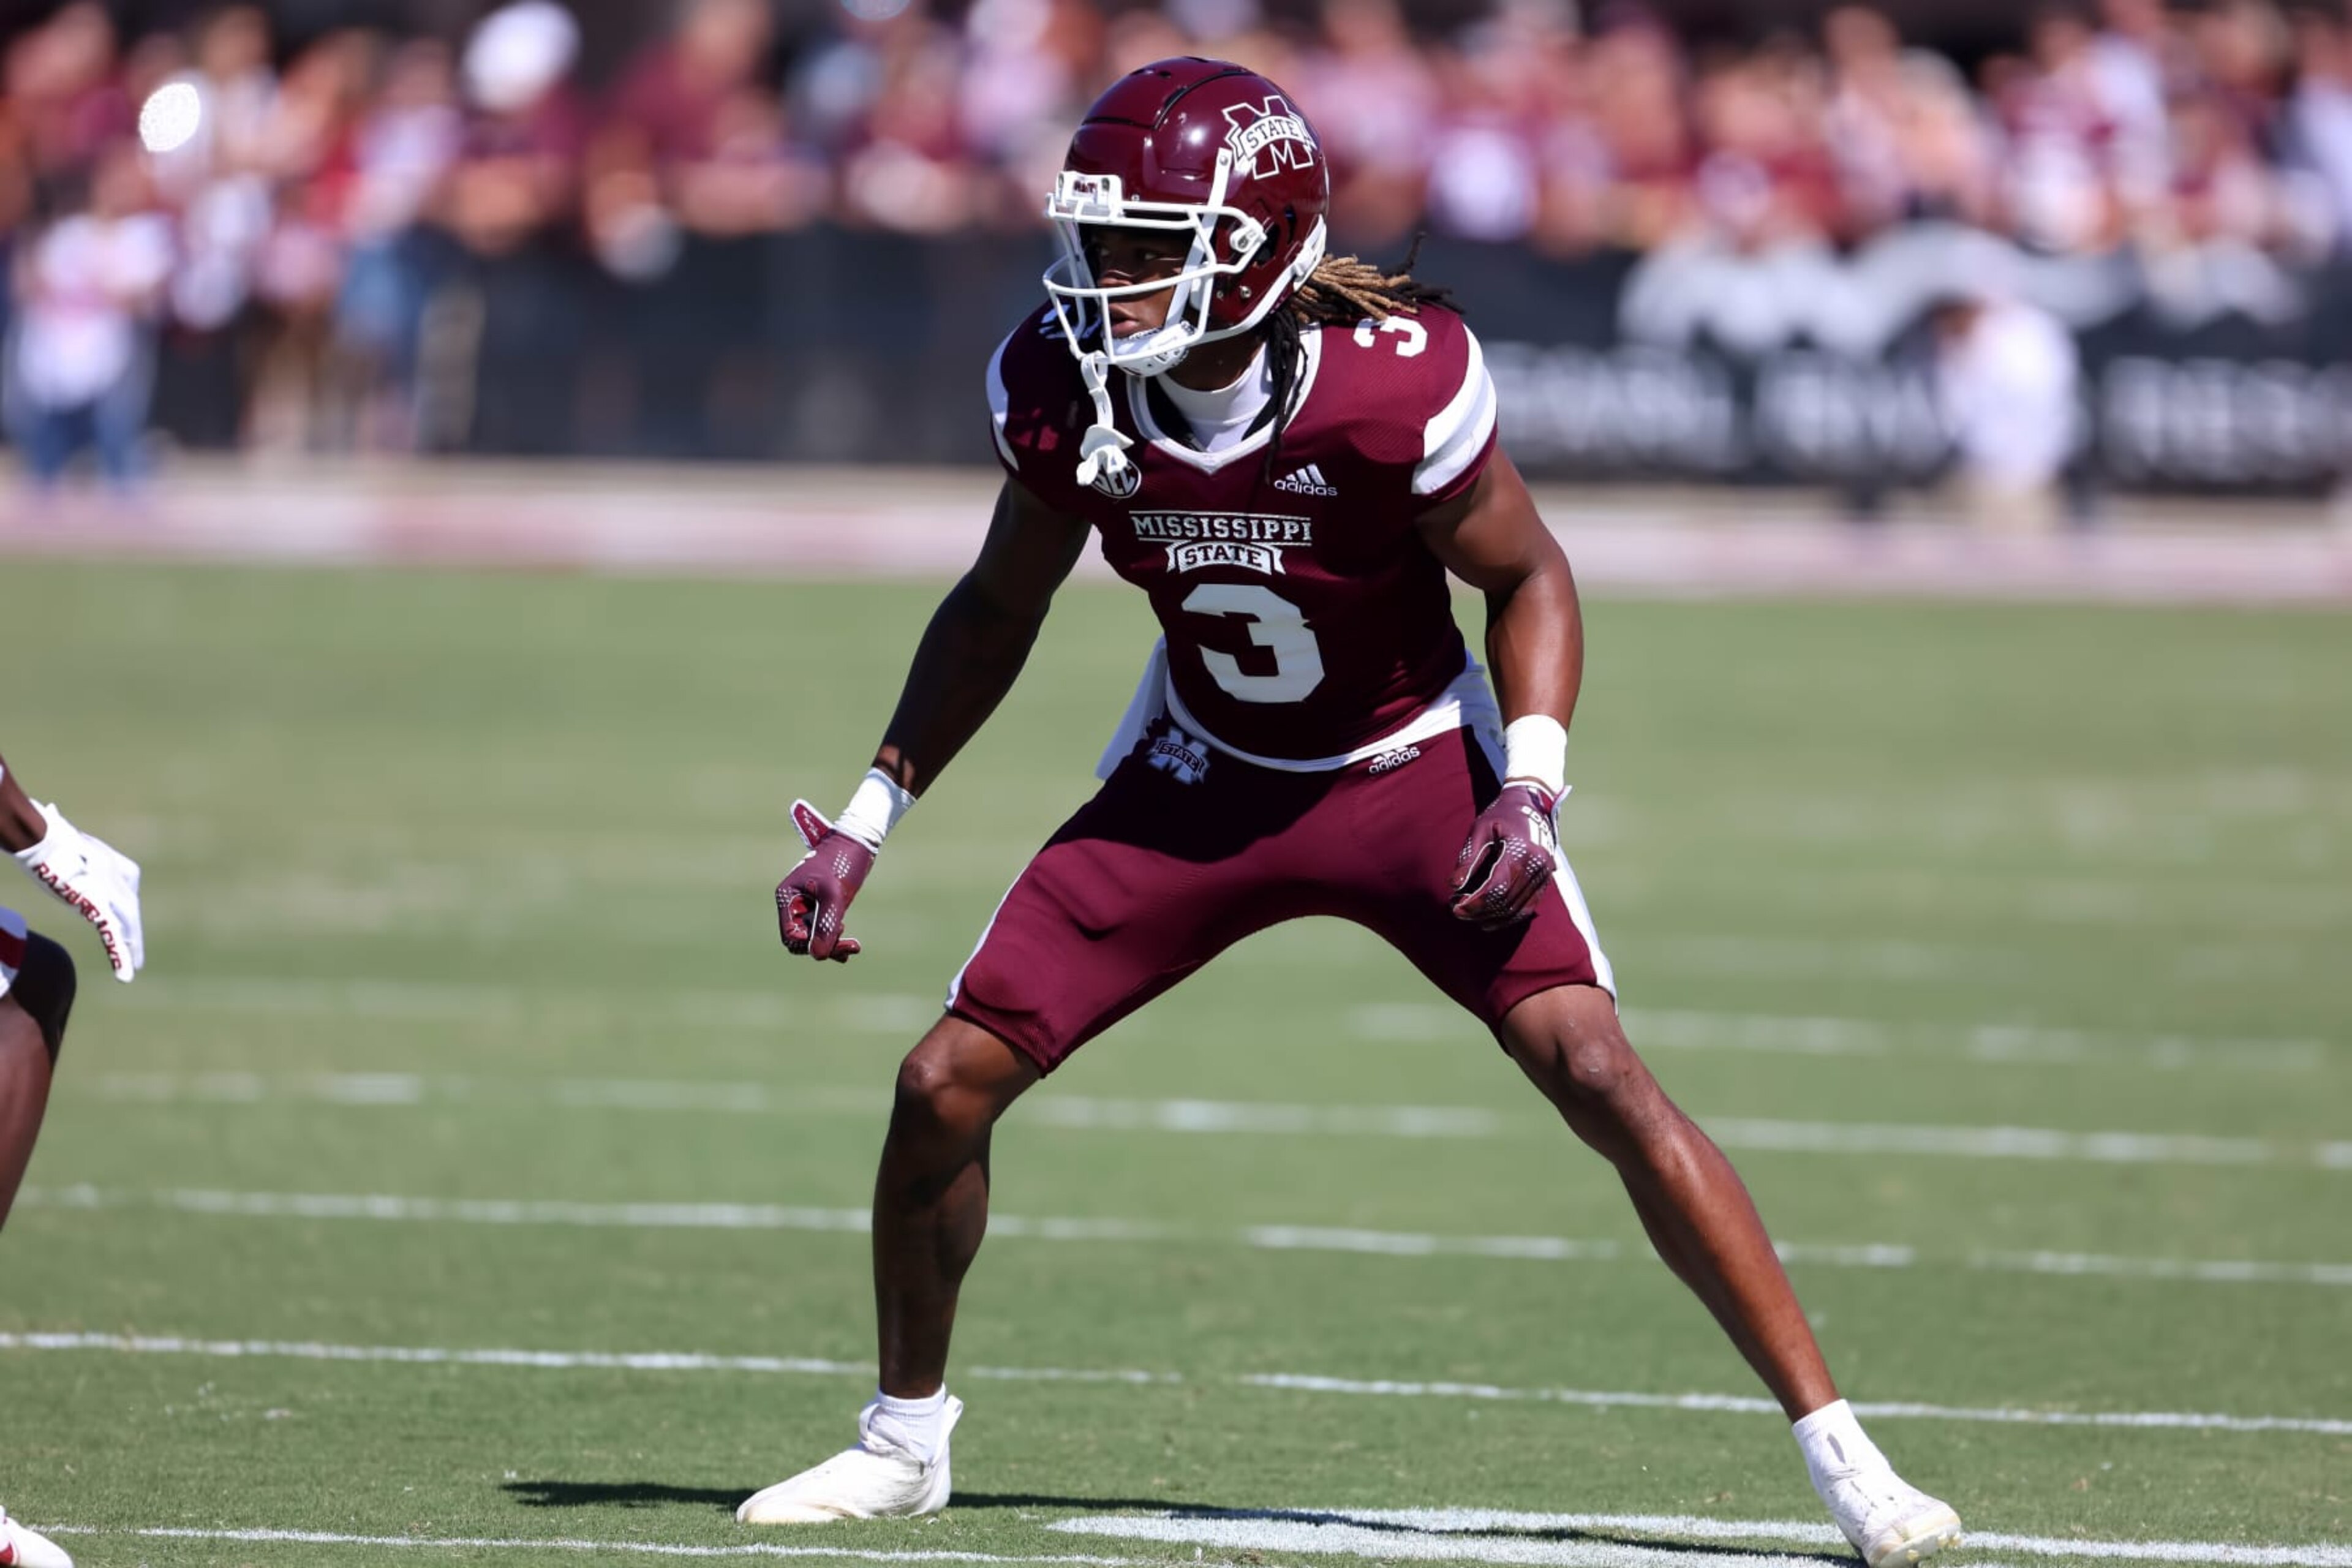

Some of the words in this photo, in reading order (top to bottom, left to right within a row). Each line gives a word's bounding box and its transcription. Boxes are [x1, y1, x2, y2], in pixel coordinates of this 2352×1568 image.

[1246, 119, 1298, 149] STATE
[1352, 315, 1428, 358] 3
[1274, 480, 1338, 496] adidas
[1131, 516, 1313, 541] MISSISSIPPI
[1185, 545, 1263, 568] STATE
[1181, 583, 1325, 703] 3
[1161, 744, 1198, 769] STATE
[1369, 747, 1420, 774] adidas
